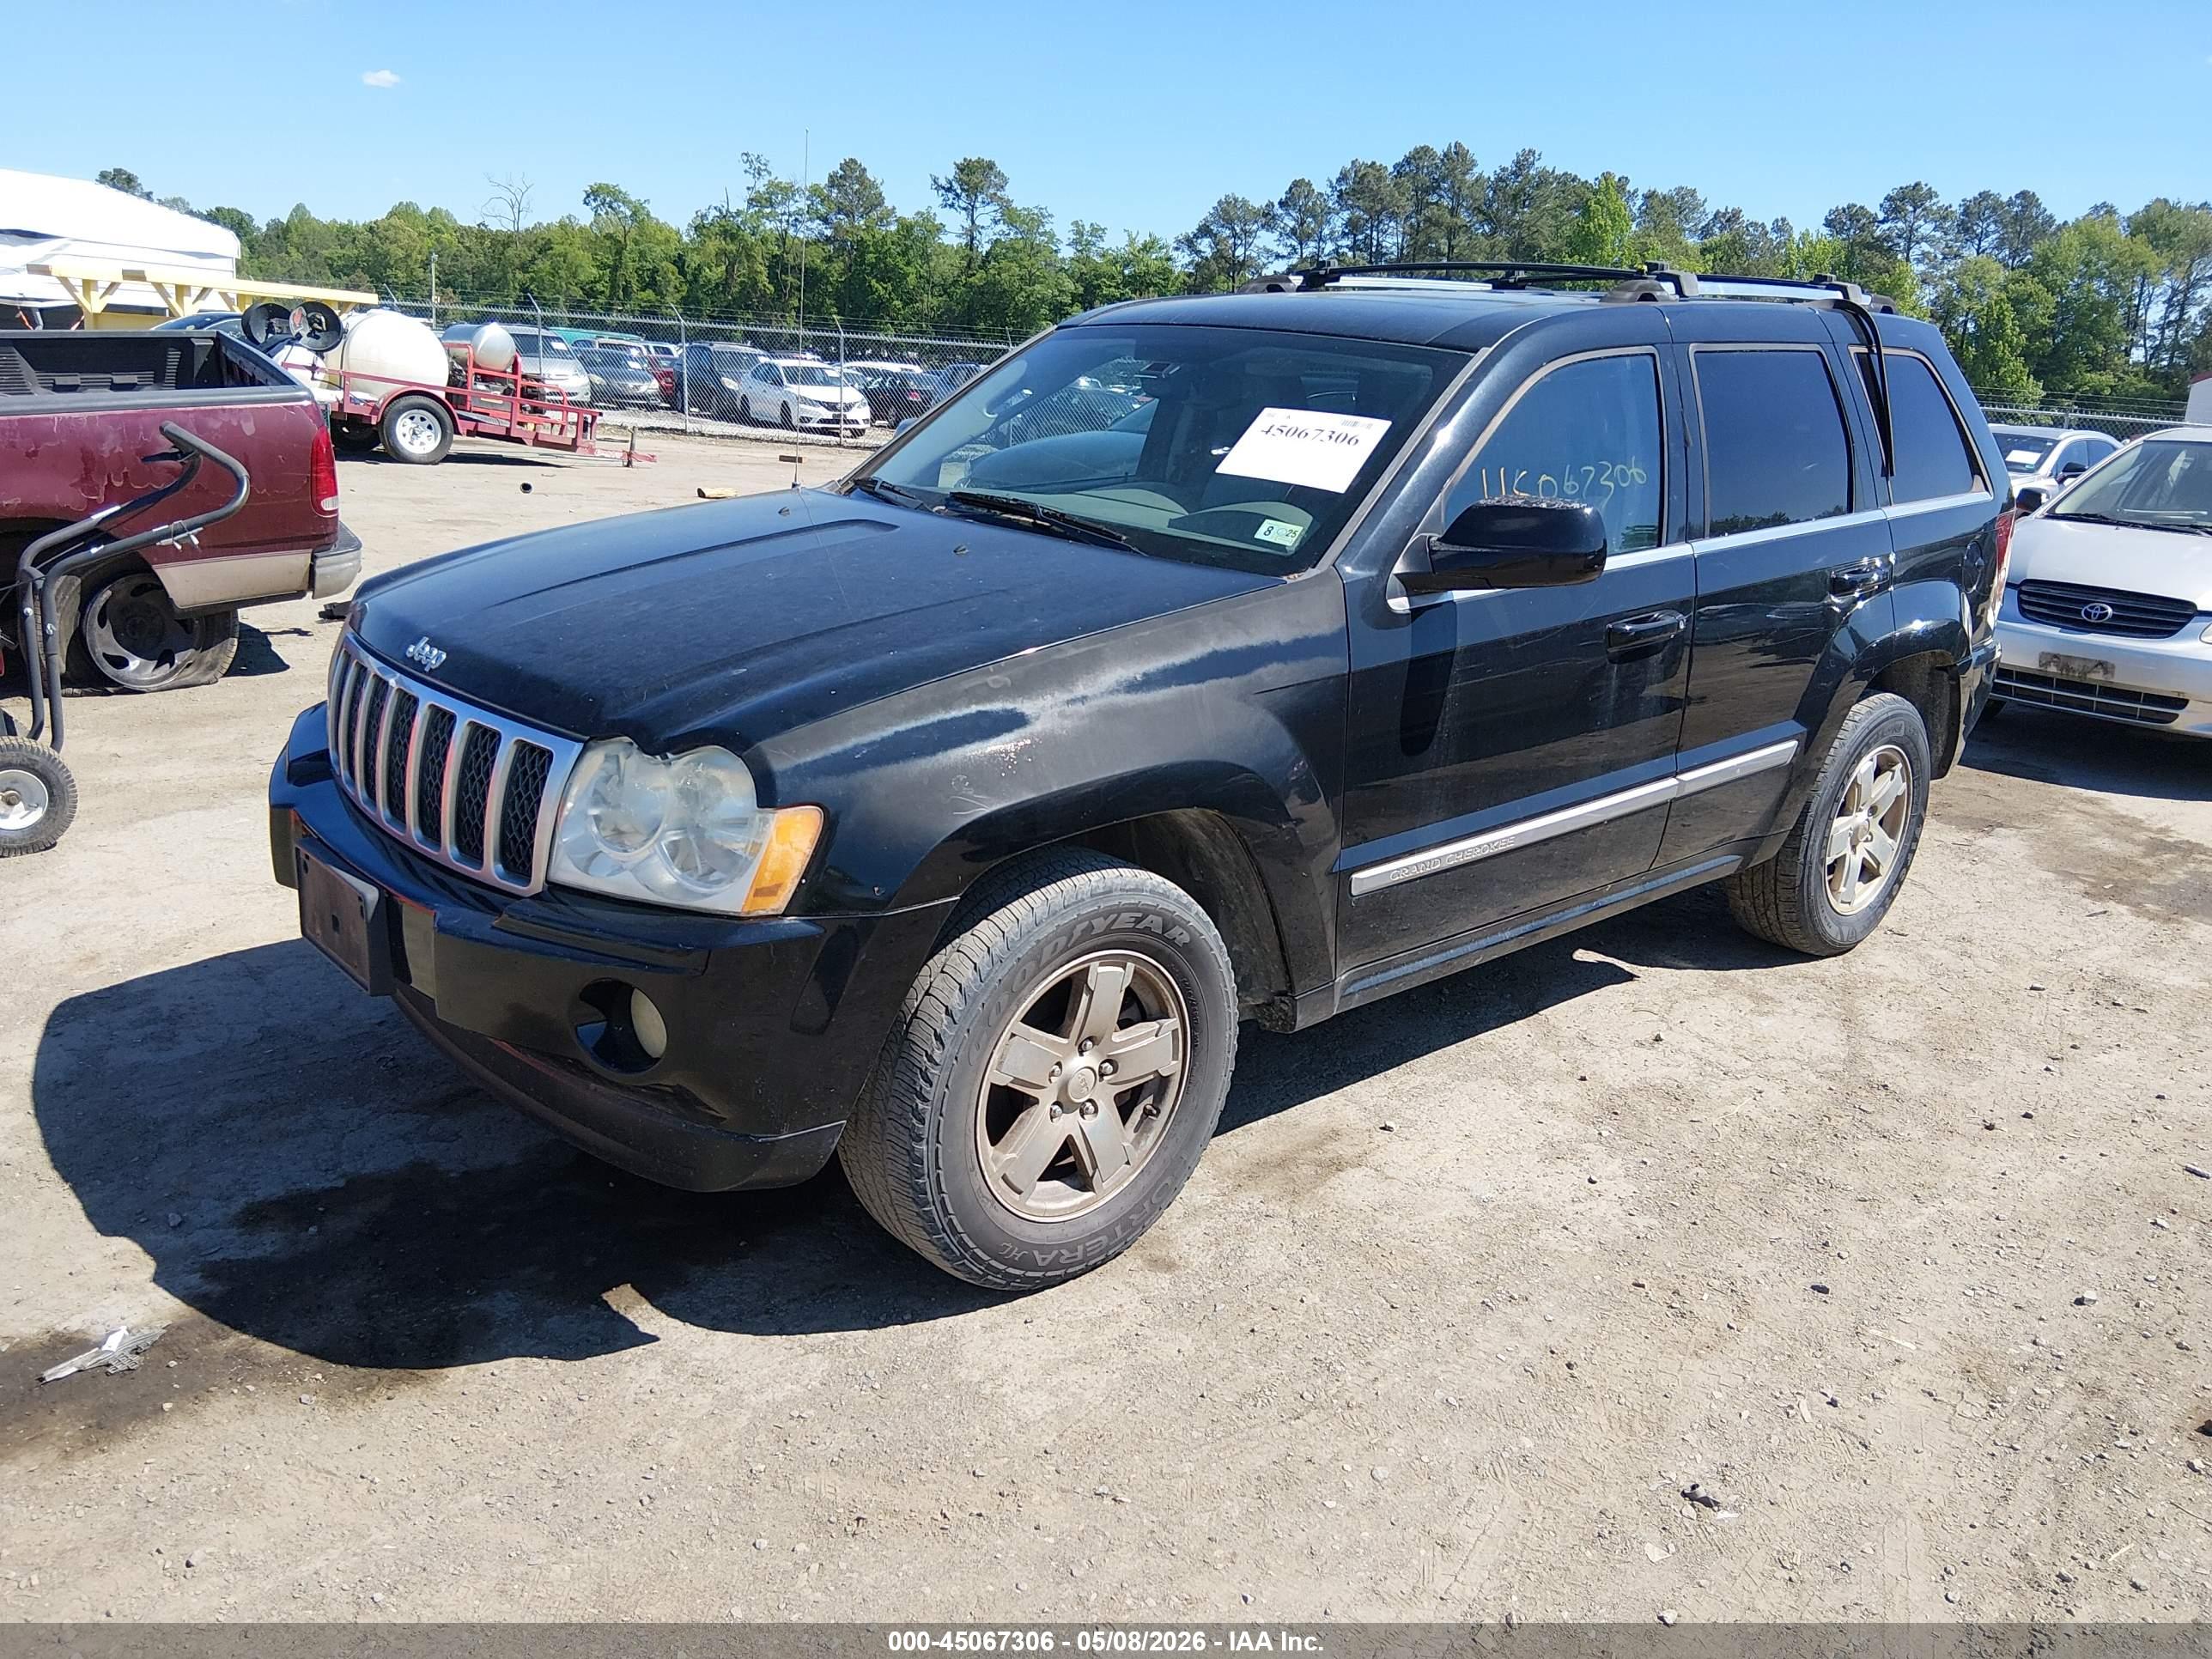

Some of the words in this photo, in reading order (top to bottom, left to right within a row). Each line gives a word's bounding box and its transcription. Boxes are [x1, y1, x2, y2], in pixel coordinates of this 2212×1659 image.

[1261, 424, 1359, 447] 45067306
[1263, 526, 1274, 537] 8
[1285, 529, 1299, 538] 25
[405, 635, 447, 672] Jeep
[1389, 859, 1441, 881] GRAND
[1446, 836, 1516, 866] CHEROKEE
